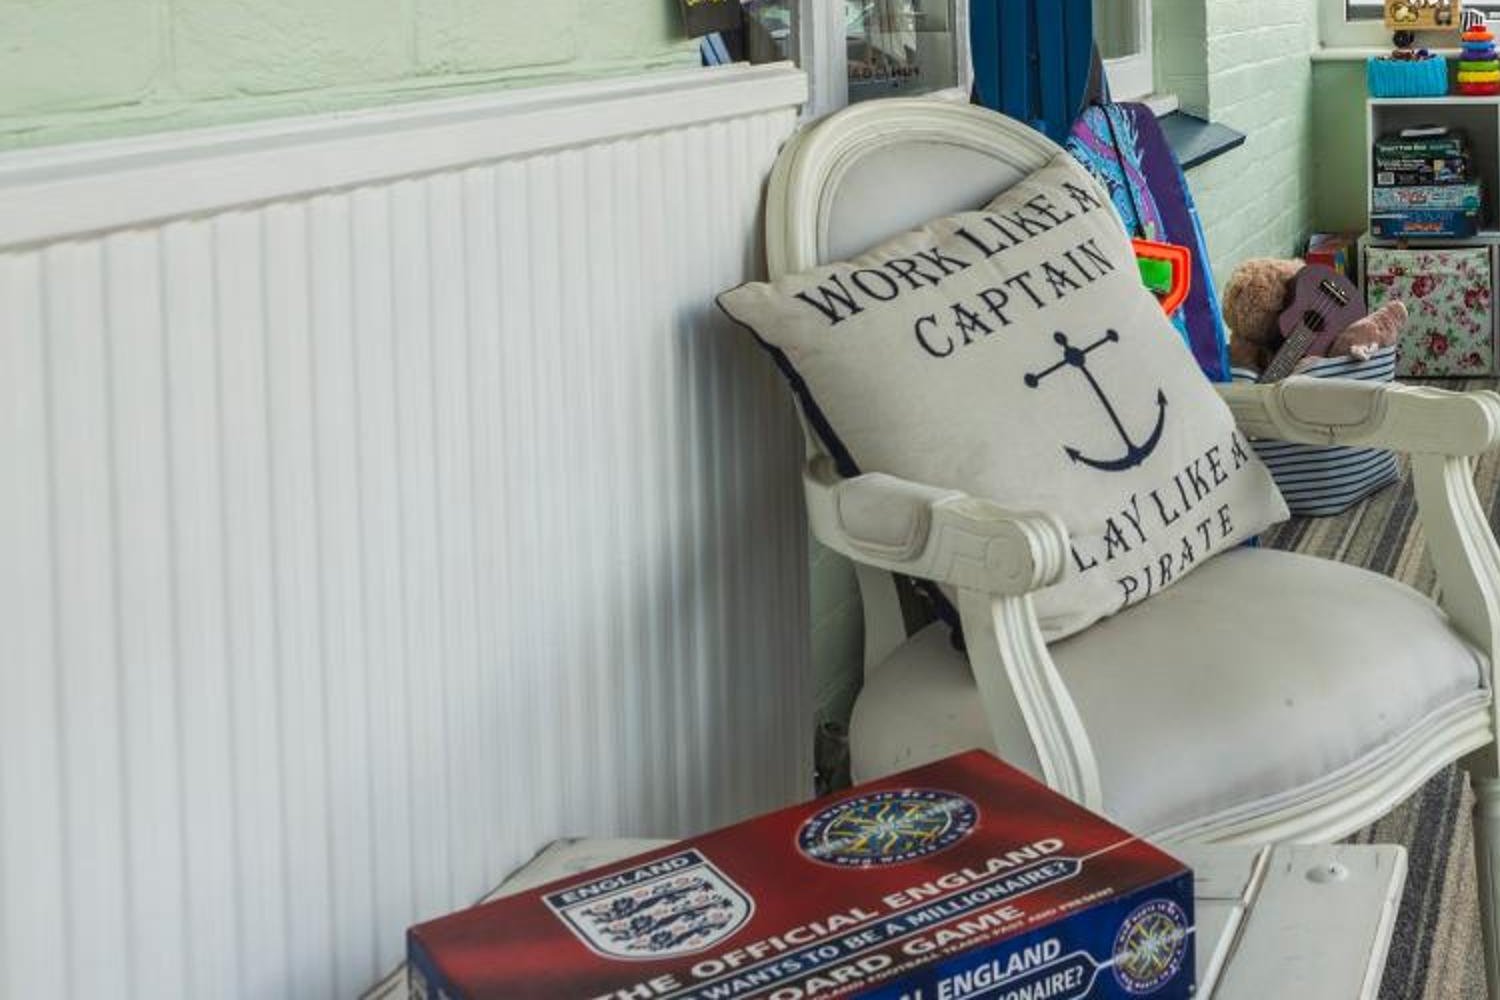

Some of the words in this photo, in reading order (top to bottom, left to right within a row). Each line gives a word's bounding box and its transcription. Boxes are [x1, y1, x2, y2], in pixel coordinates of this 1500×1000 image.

[795, 246, 970, 326] WORK
[957, 192, 1073, 260] LIKE
[1062, 181, 1103, 213] A
[914, 238, 1117, 358] CAPTAIN
[1070, 498, 1148, 573] LAY
[1148, 452, 1230, 528] LIKE
[1229, 431, 1249, 466] A
[1118, 503, 1236, 604] PIRATE
[561, 856, 689, 903] ENGLAND
[690, 907, 878, 977] OFFICIAL
[882, 838, 1064, 909] ENGLAND
[701, 958, 802, 999] WANTS
[802, 945, 839, 963] TO
[843, 928, 883, 950] BE
[885, 922, 906, 936] A
[905, 861, 1067, 927] MILLIONAIRE?
[768, 953, 893, 1000] OARD
[903, 905, 1025, 956] GAME
[937, 938, 1061, 1000] ENGLAND
